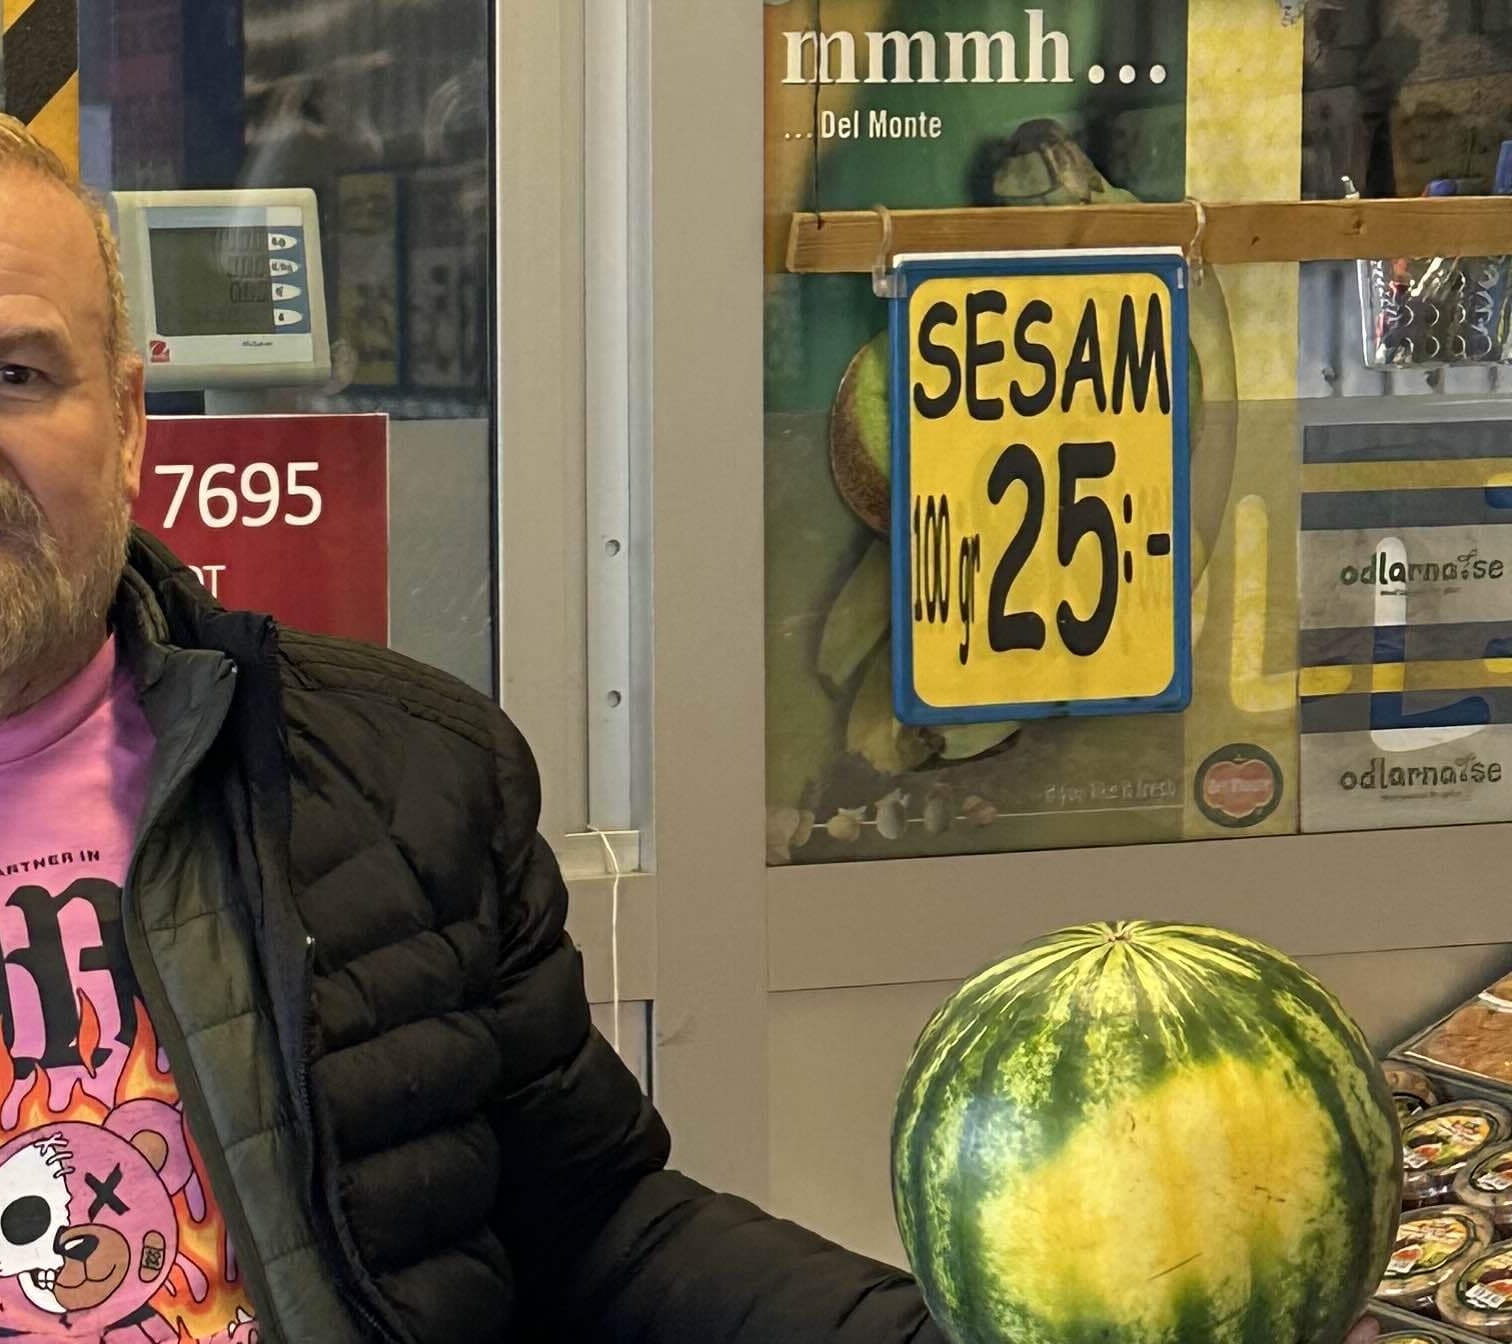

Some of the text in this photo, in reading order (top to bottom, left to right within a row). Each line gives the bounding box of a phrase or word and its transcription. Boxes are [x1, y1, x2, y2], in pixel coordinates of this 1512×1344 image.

[869, 110, 943, 139] Monte
[913, 290, 1170, 421] SESAM
[154, 462, 322, 529] 7695
[914, 494, 950, 624] 100
[80, 850, 101, 863] IN
